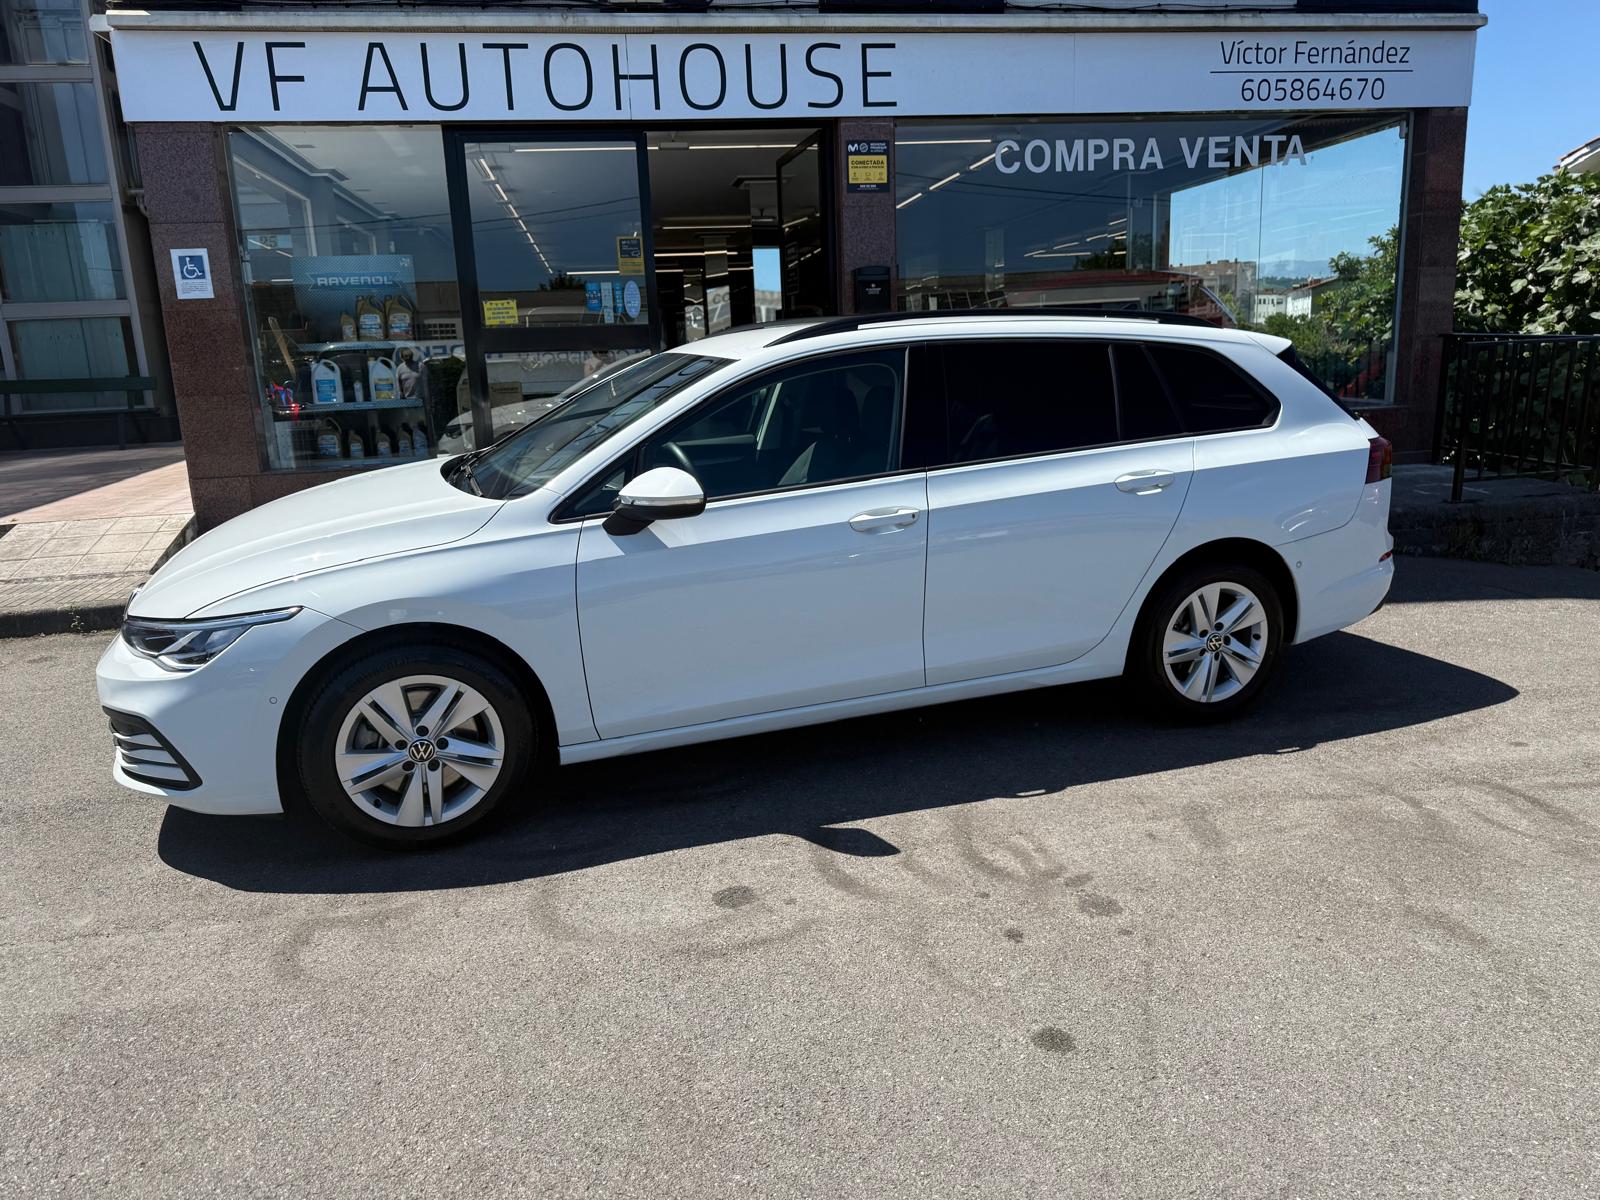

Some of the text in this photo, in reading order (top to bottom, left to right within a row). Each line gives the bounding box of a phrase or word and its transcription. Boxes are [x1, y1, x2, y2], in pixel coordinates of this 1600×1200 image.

[1220, 39, 1411, 65] Víctor Fernández
[192, 40, 898, 112] VF AUTOHOUSE
[1241, 77, 1385, 102] 605864670
[994, 135, 1307, 174] COMPRA VENTA
[316, 275, 393, 287] RAVENOL
